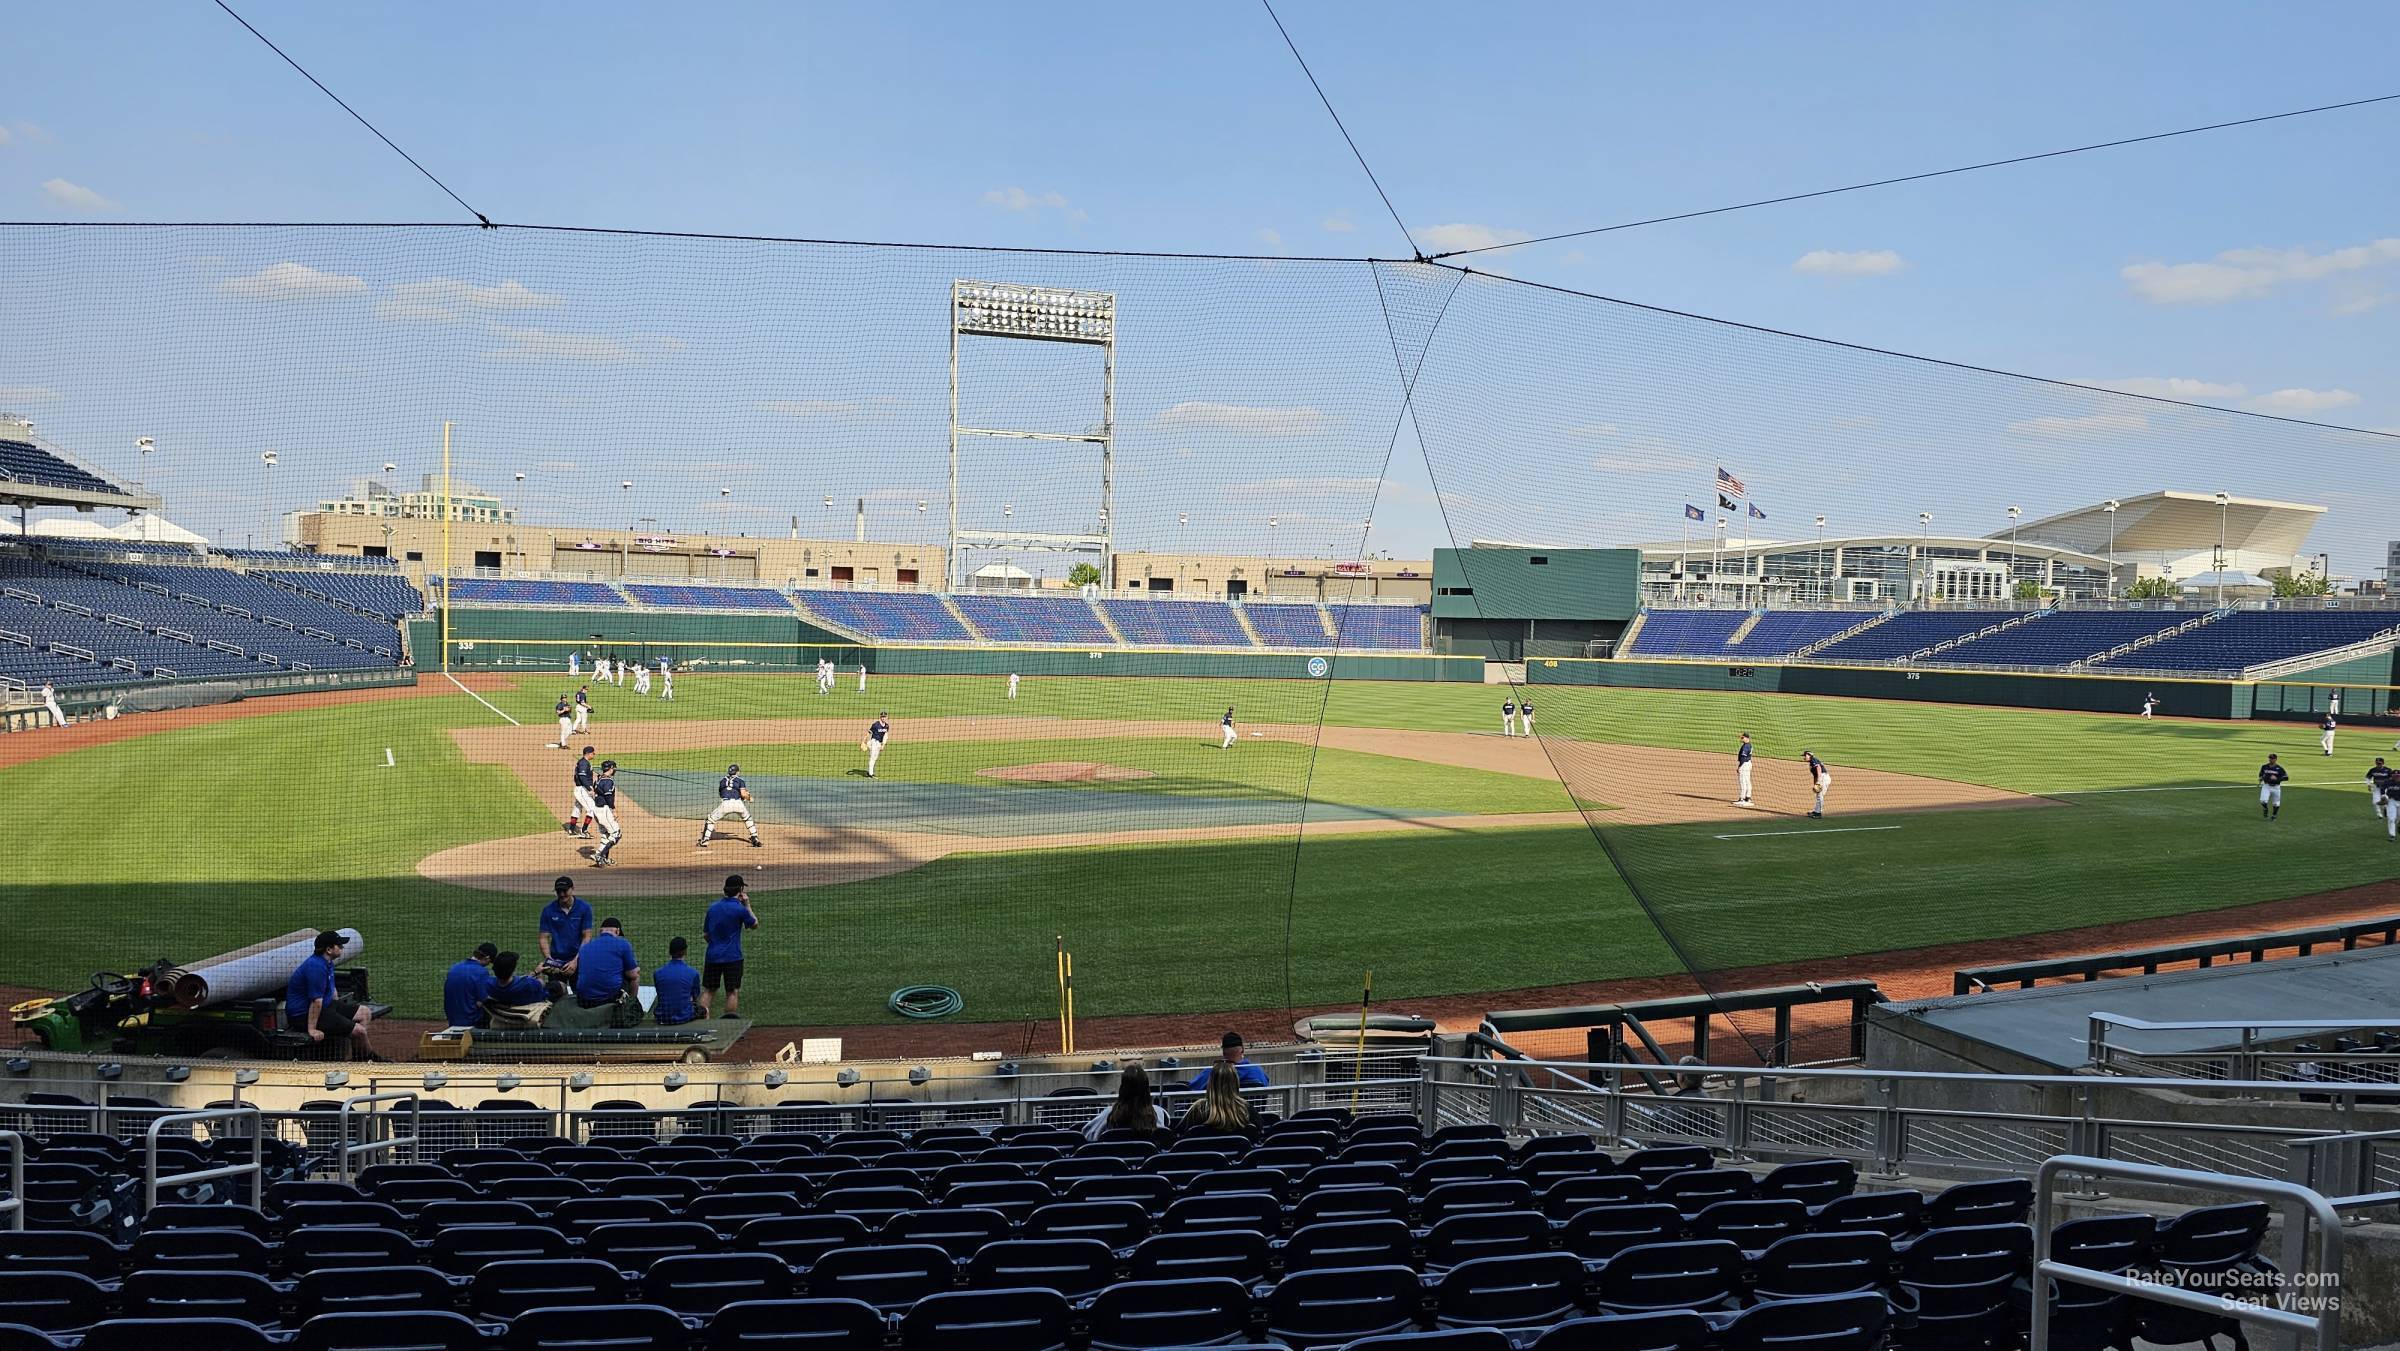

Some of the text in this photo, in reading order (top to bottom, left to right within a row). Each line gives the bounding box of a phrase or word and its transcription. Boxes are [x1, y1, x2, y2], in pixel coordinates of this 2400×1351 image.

[458, 641, 474, 650] 335
[1310, 662, 1325, 671] CG
[1906, 672, 1920, 680] 375
